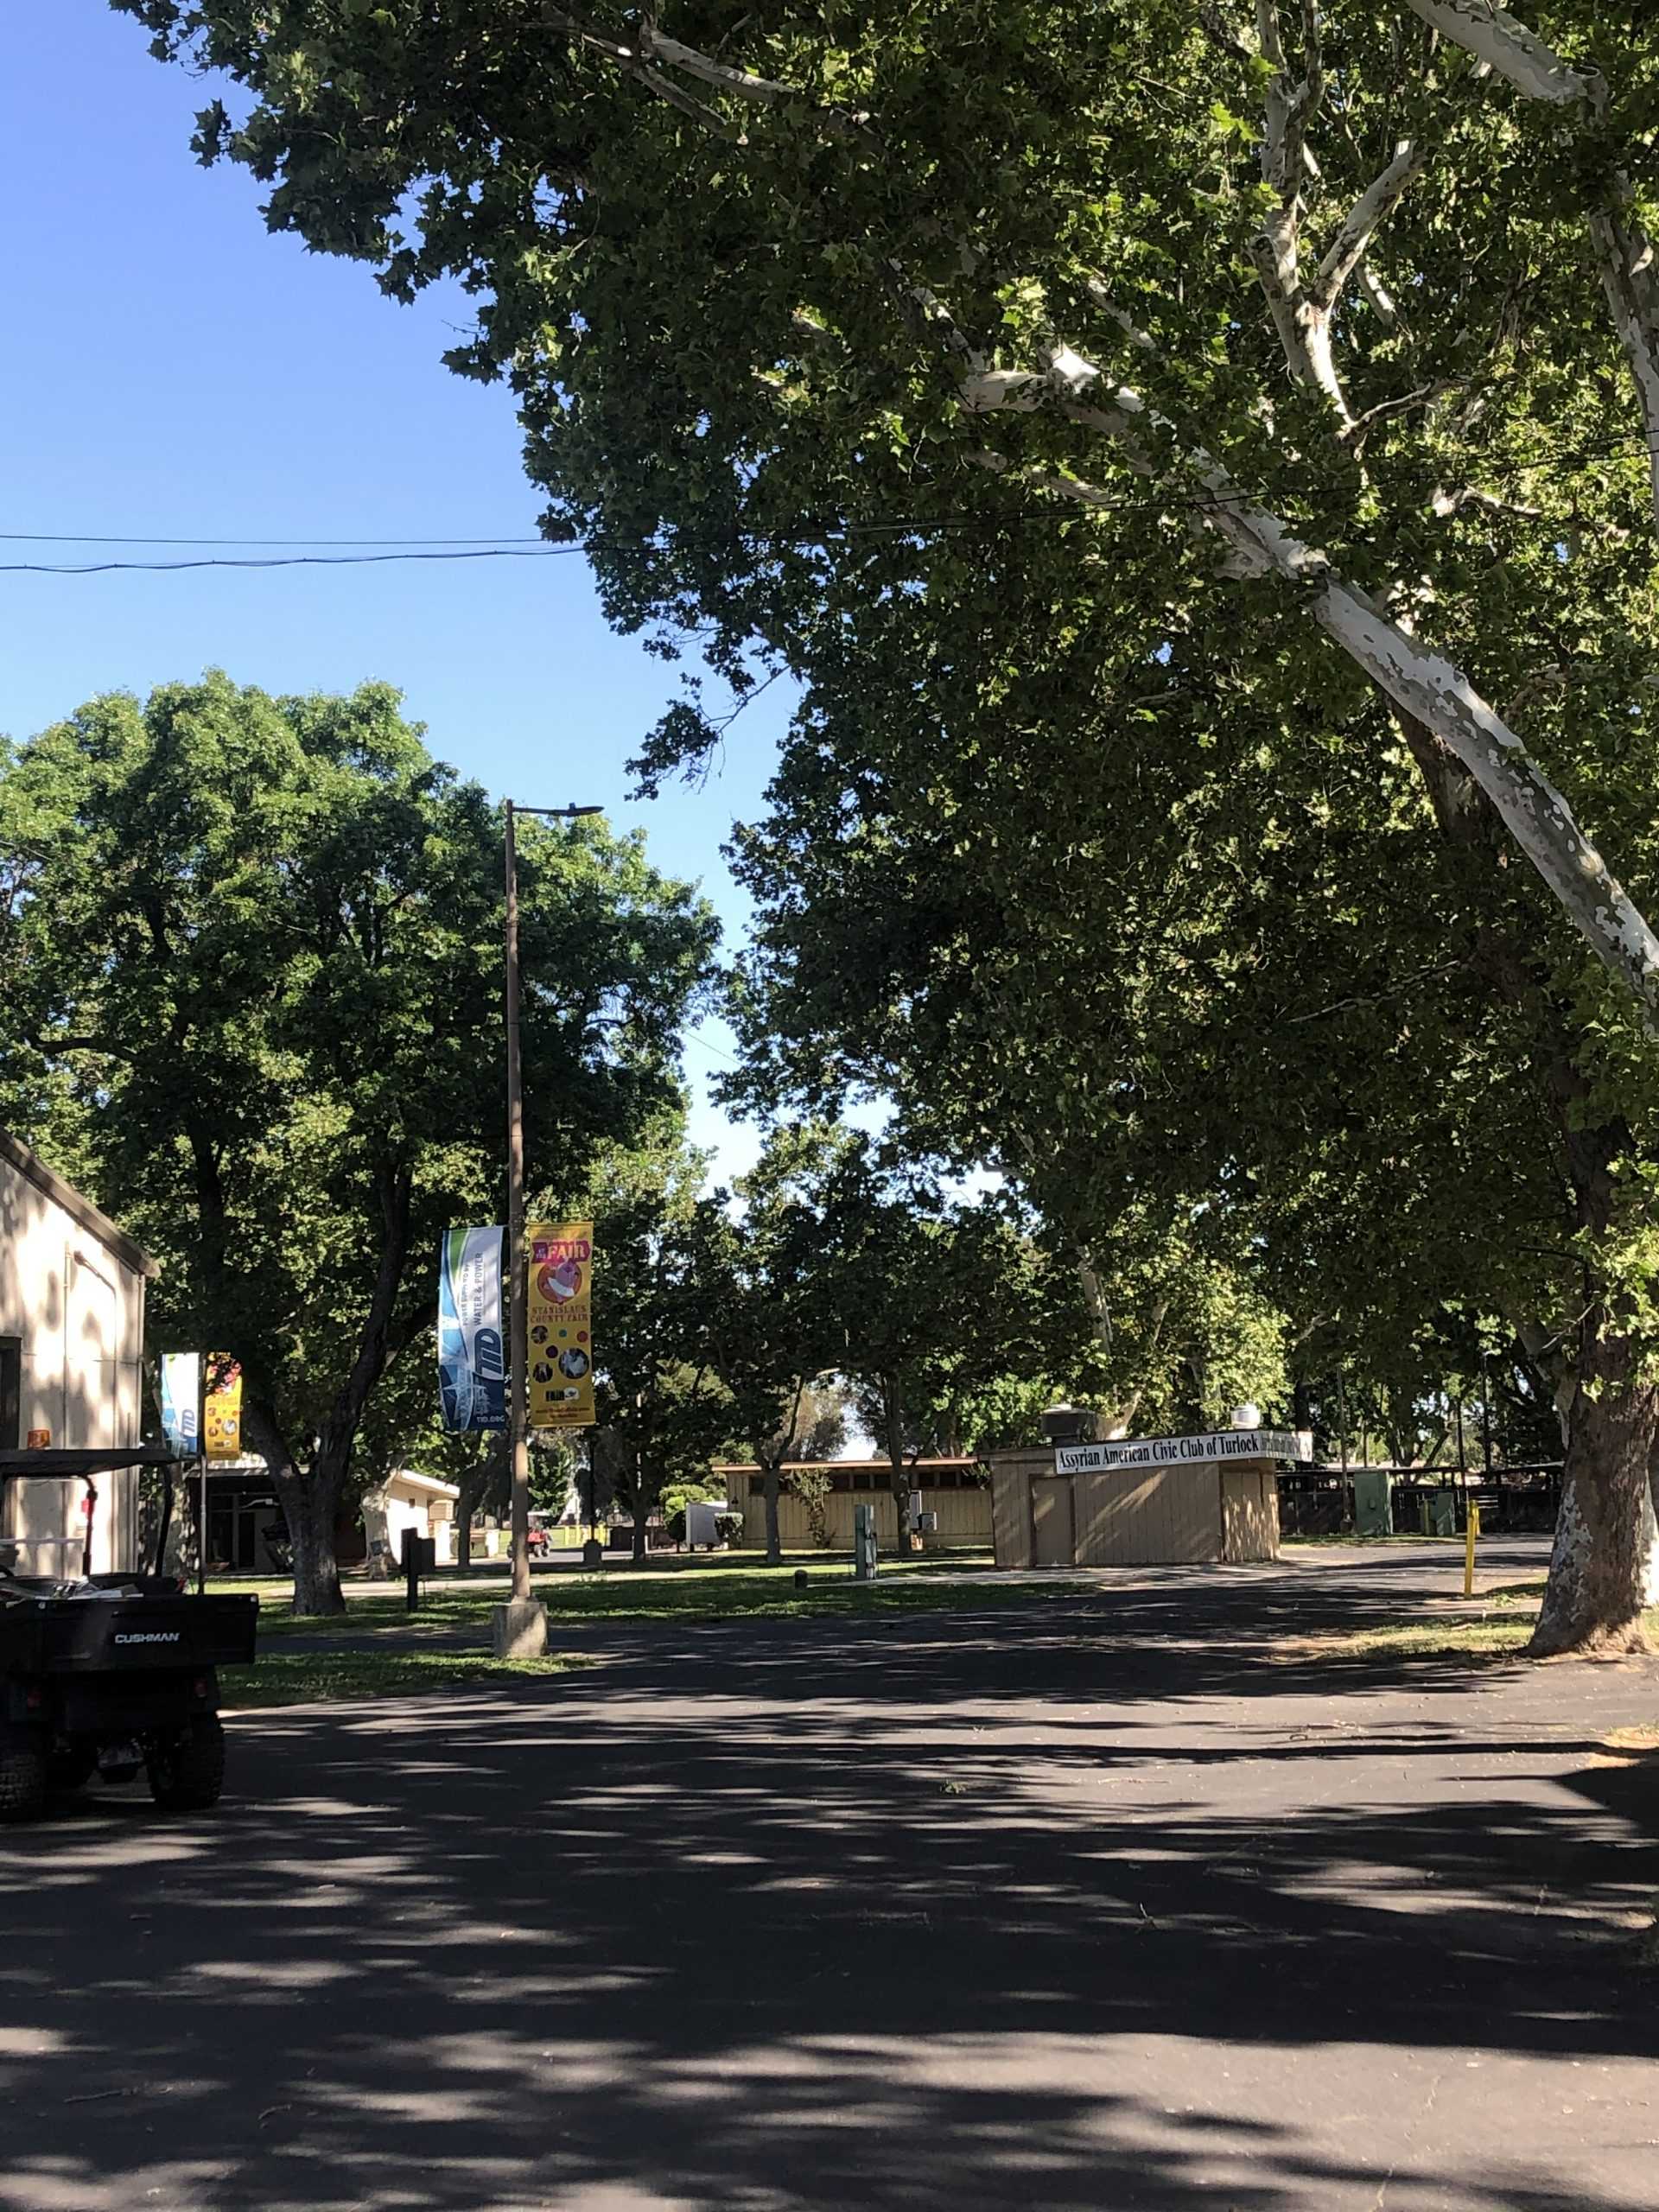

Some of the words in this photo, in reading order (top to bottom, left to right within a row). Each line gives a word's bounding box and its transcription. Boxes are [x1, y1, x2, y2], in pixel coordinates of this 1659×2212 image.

[547, 1244, 586, 1260] FAIR
[474, 1252, 483, 1284] POWER
[474, 1295, 482, 1326] WATER
[531, 1304, 588, 1314] STANISLAUS
[531, 1313, 564, 1324] COUNTY
[567, 1313, 588, 1322] FAIR
[1059, 1449, 1101, 1472] Assyrian
[1103, 1444, 1150, 1465] American
[1153, 1440, 1178, 1460] Civic
[1180, 1438, 1204, 1458] Club
[1206, 1435, 1217, 1454] of
[1218, 1433, 1259, 1454] Turlock
[115, 1632, 180, 1643] CUSHMAN
